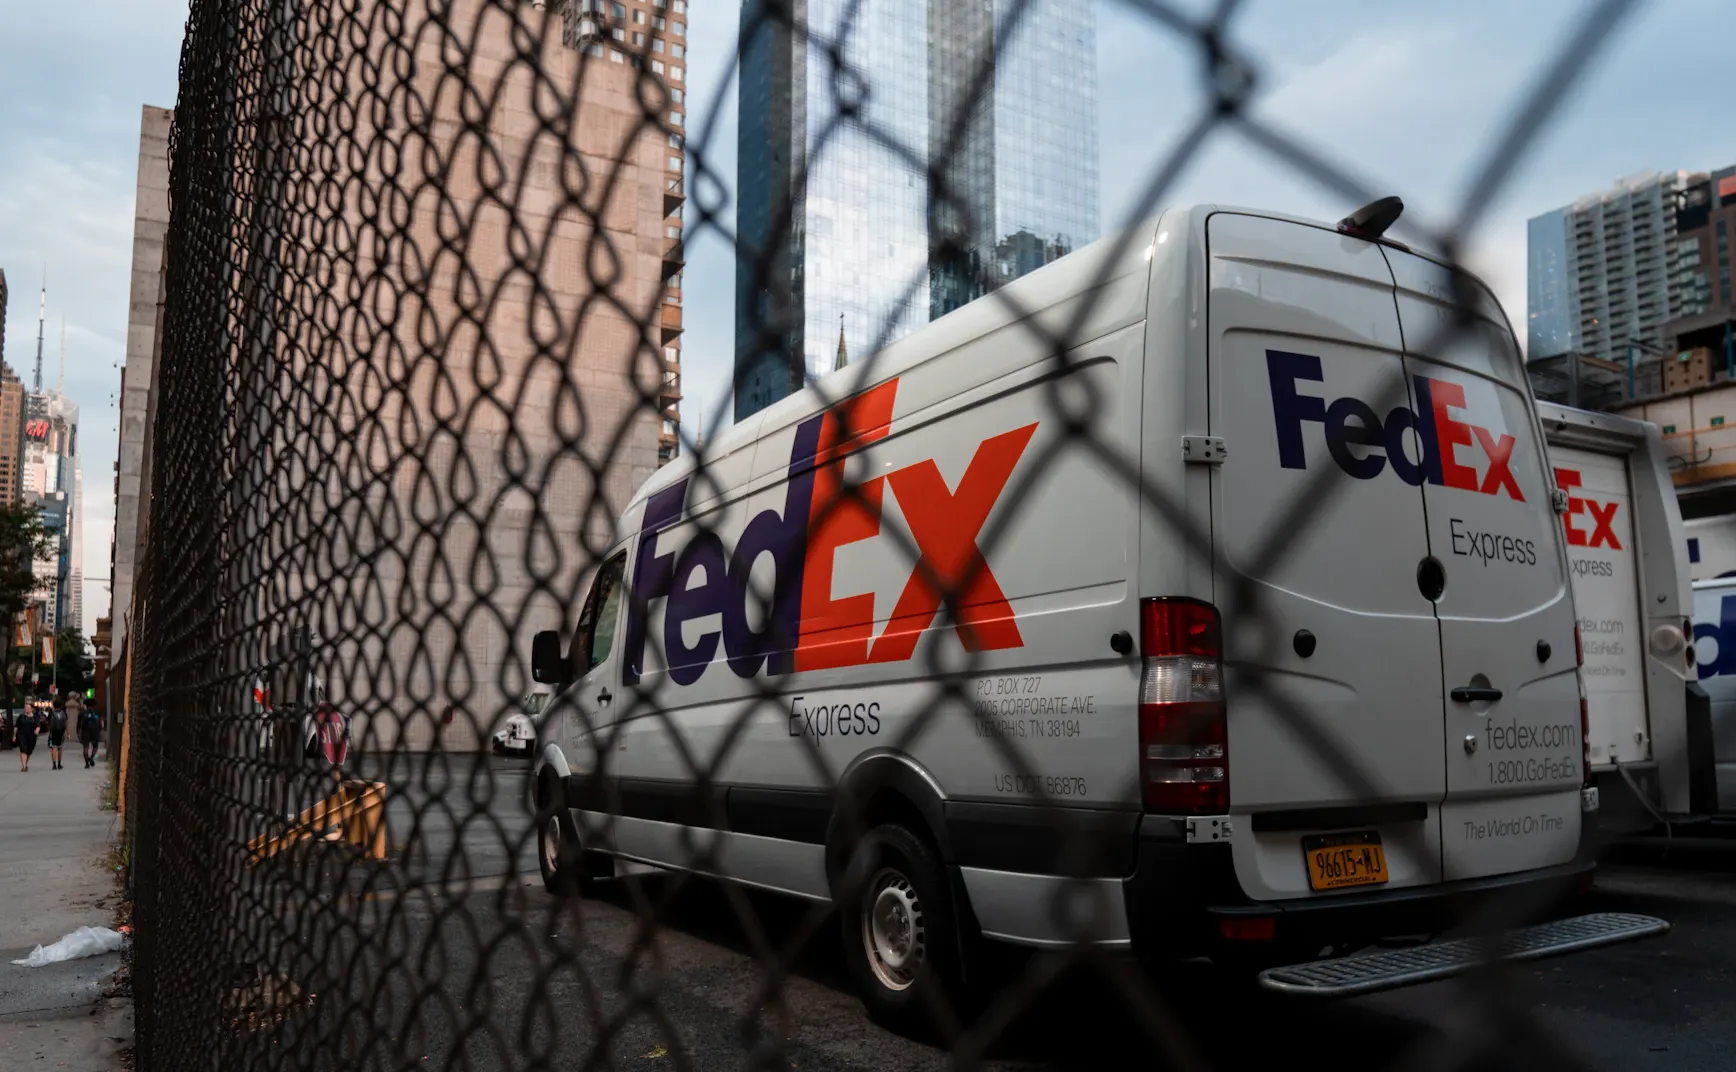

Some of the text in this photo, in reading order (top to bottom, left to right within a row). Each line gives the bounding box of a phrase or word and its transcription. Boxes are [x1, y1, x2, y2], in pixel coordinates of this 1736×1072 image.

[1265, 348, 1527, 503] FedEx
[1553, 466, 1623, 551] Ex
[622, 376, 1041, 687] FedEx
[1450, 518, 1537, 567] Express
[1572, 559, 1613, 579] xpress
[1580, 616, 1624, 635] dex.com
[976, 676, 1042, 696] P.O. BOX 727
[1000, 696, 1068, 716] CORPORATE
[1071, 695, 1097, 714] AVE.
[789, 696, 880, 746] Express
[1029, 720, 1044, 737] TN
[1047, 719, 1081, 738] 38194
[1485, 717, 1575, 751] fedex.com
[1487, 755, 1578, 784] 1.800.GoFedEx
[994, 773, 1013, 793] US
[1046, 776, 1087, 796] 86876
[1463, 814, 1564, 841] The World On Time
